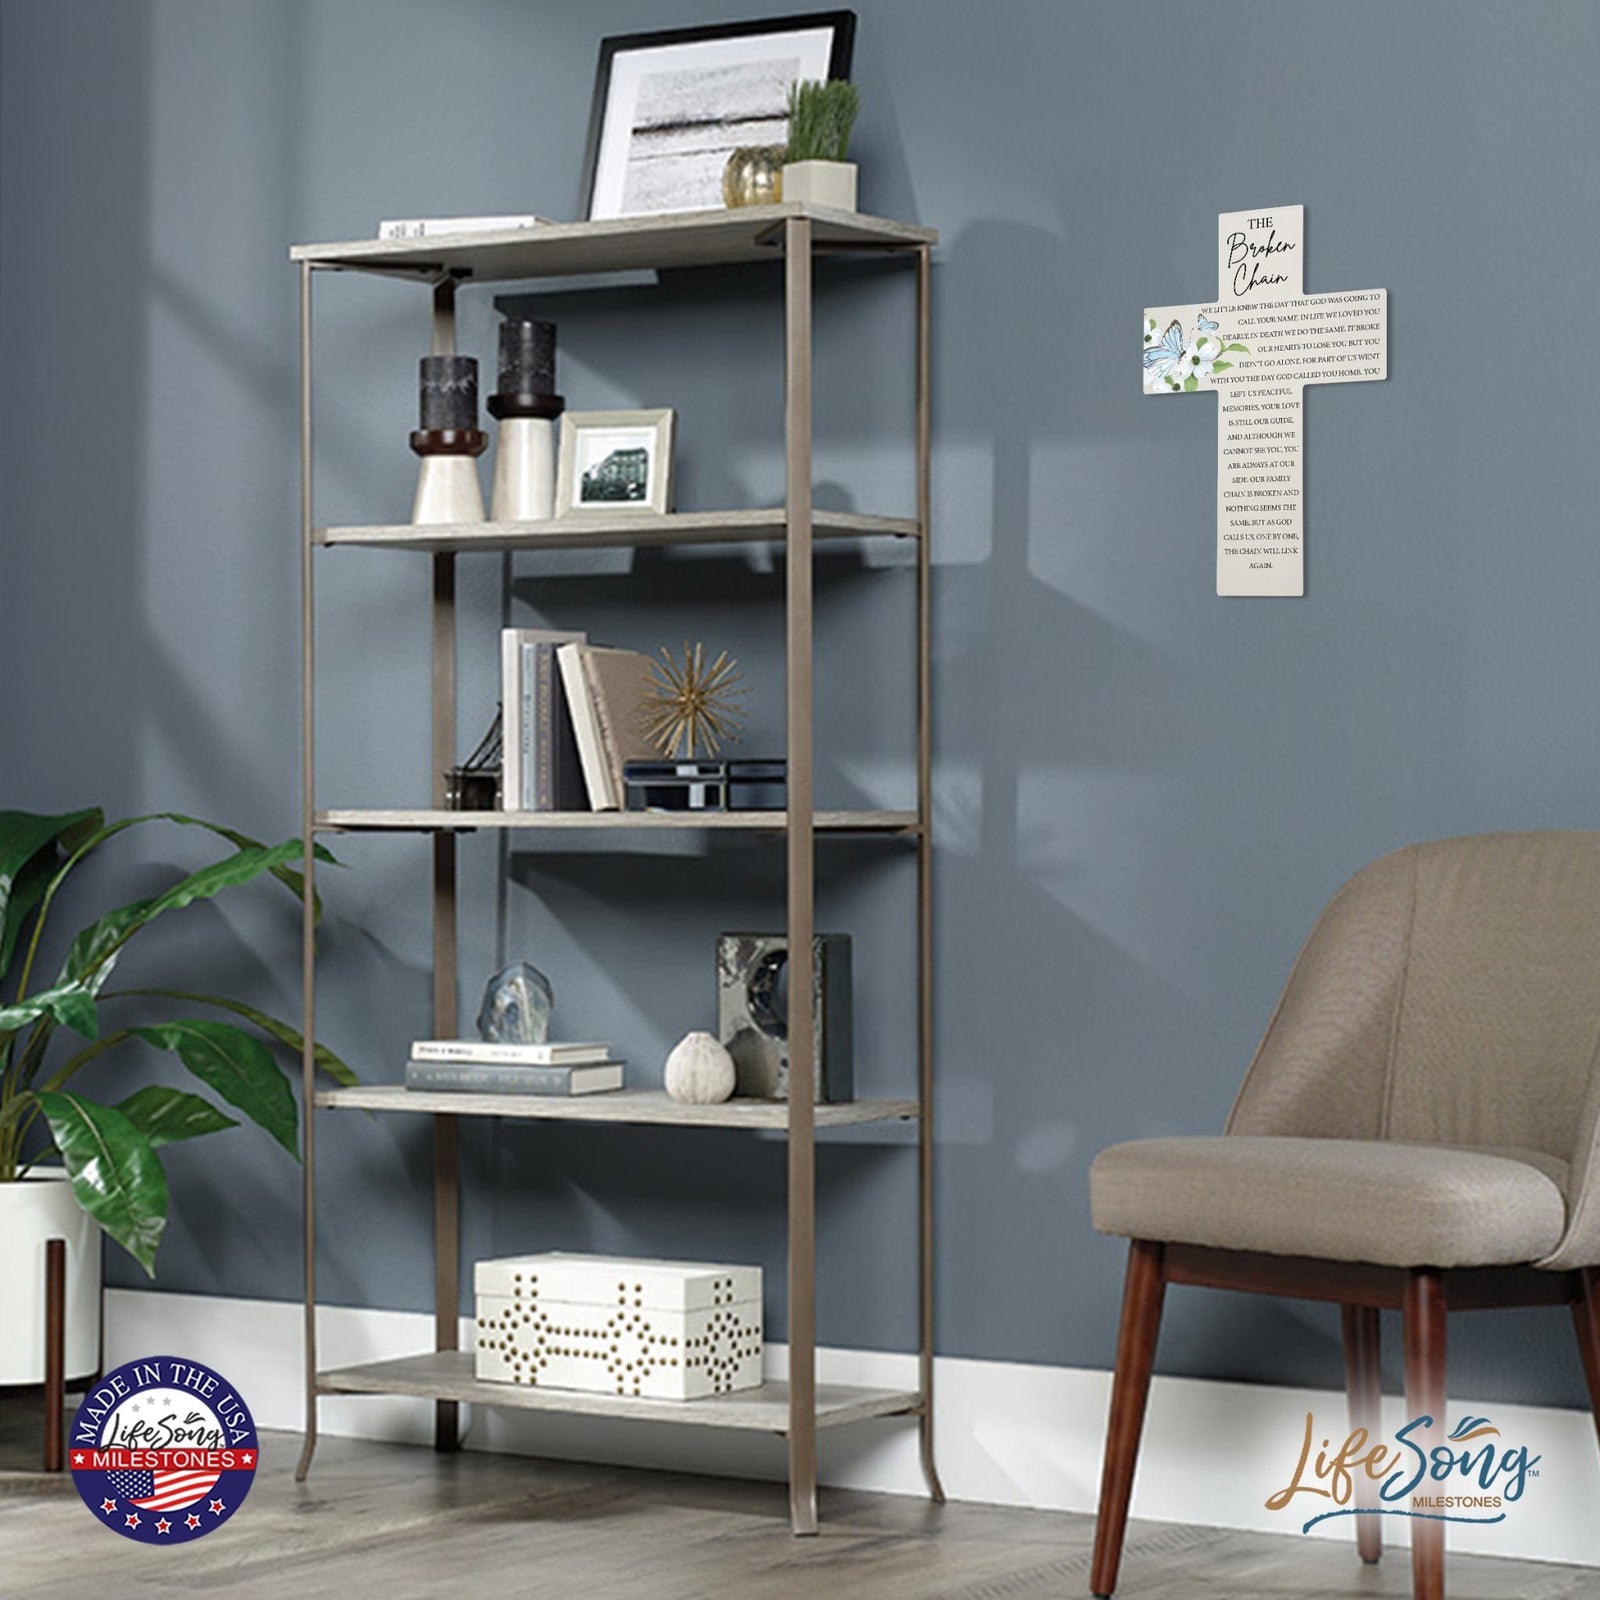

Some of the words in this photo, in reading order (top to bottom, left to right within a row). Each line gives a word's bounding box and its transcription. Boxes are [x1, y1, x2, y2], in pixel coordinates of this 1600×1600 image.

[1247, 216, 1273, 230] THE
[1227, 230, 1295, 268] Broken
[1233, 263, 1288, 297] Chain
[1213, 305, 1236, 313] LITTLE
[1238, 304, 1258, 312] KNEW
[1260, 302, 1274, 310] THE
[1356, 323, 1380, 331] BROKE
[1274, 344, 1300, 352] HEARTS
[1331, 340, 1347, 348] YOU
[1318, 355, 1336, 363] PART
[1210, 377, 1229, 385] WITH
[1276, 372, 1293, 380] GOD
[1294, 371, 1320, 379] CALLED
[1258, 388, 1292, 396] PEACEFUL
[1244, 432, 1282, 440] ALTHOUGH
